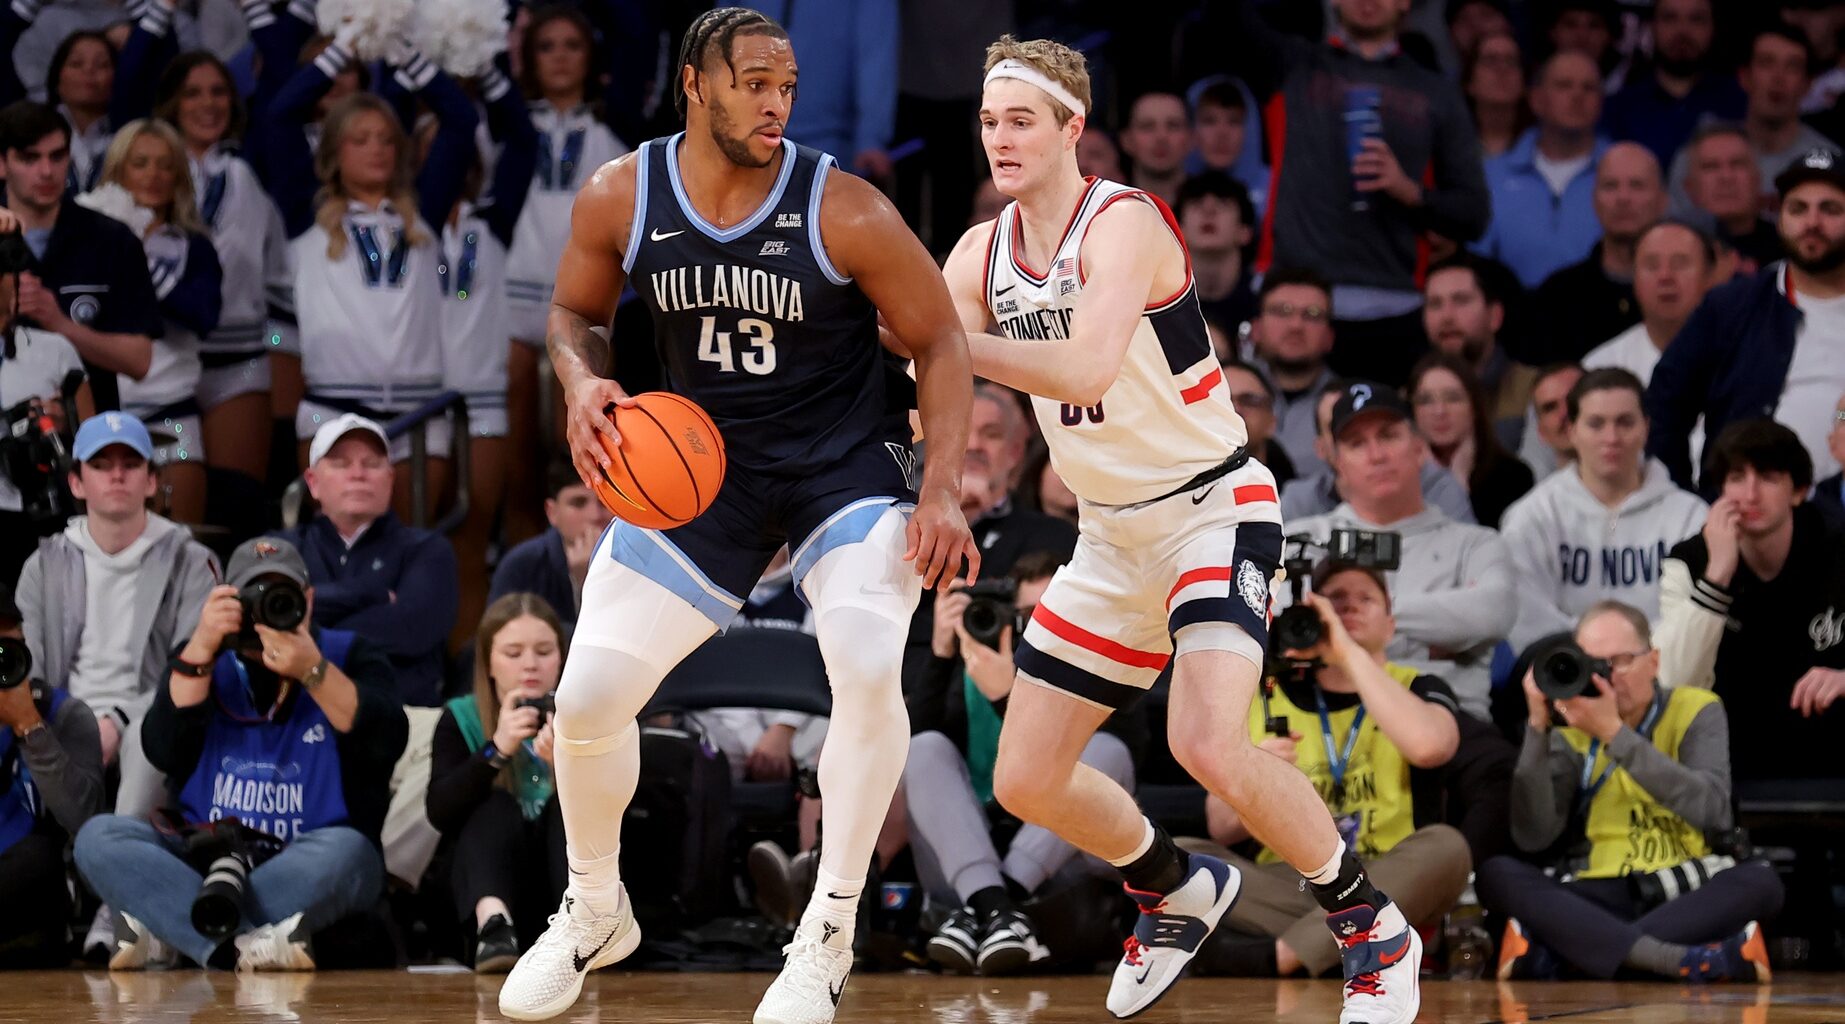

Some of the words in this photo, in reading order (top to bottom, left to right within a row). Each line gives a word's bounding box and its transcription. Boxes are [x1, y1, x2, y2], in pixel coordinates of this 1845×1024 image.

[763, 241, 785, 249] BIG
[651, 264, 804, 322] VILLANOVA
[997, 305, 1019, 315] CHANGE
[697, 316, 777, 375] 43
[302, 723, 325, 743] 43
[212, 772, 303, 814] MADISON
[208, 806, 304, 841] SARE
